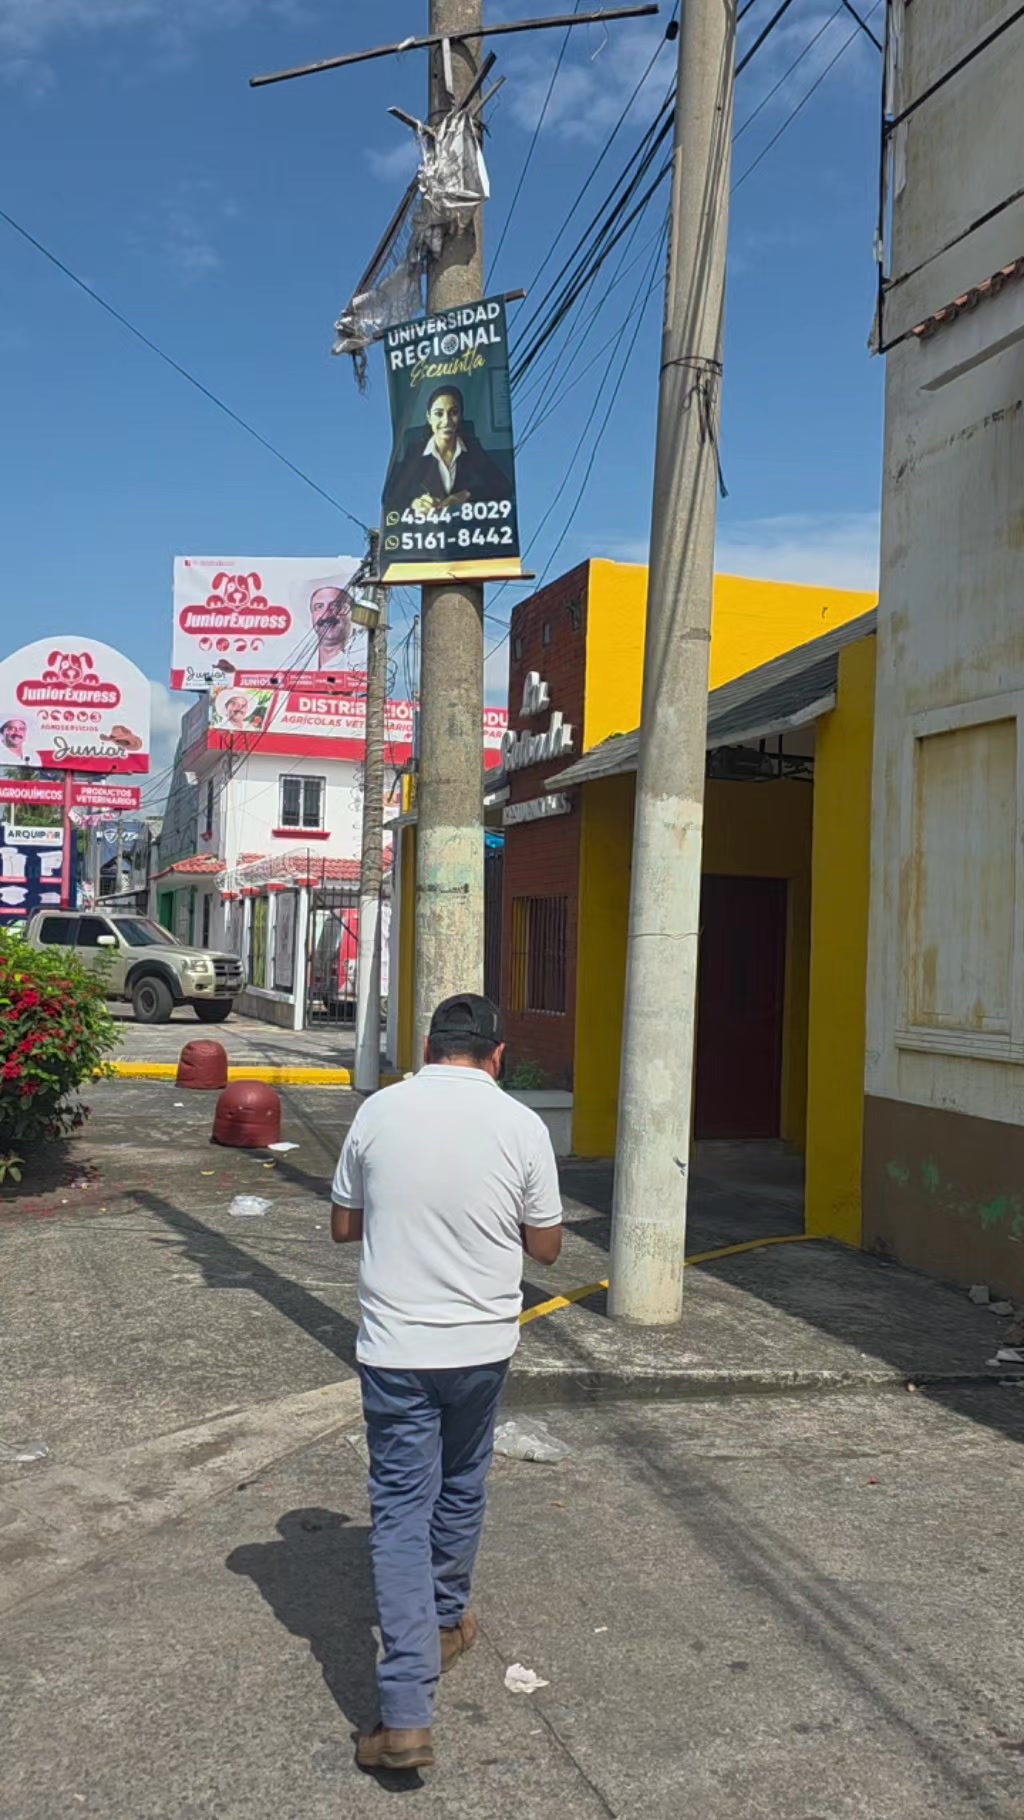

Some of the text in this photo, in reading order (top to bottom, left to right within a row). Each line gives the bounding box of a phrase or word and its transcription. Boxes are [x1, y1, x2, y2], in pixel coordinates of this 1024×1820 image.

[388, 302, 501, 347] UNIVERSIDAD
[390, 323, 501, 370] REGIONAL
[400, 500, 512, 526] 4544-8029
[401, 526, 513, 551] 5161-8442
[184, 611, 287, 630] JuniorExpress
[22, 686, 117, 704] JuniorExpress
[281, 714, 342, 728] AGRÍCOLAS
[53, 736, 126, 760] Junior
[76, 795, 137, 806] VETERINARIOS
[80, 787, 132, 797] PRODUCTOS
